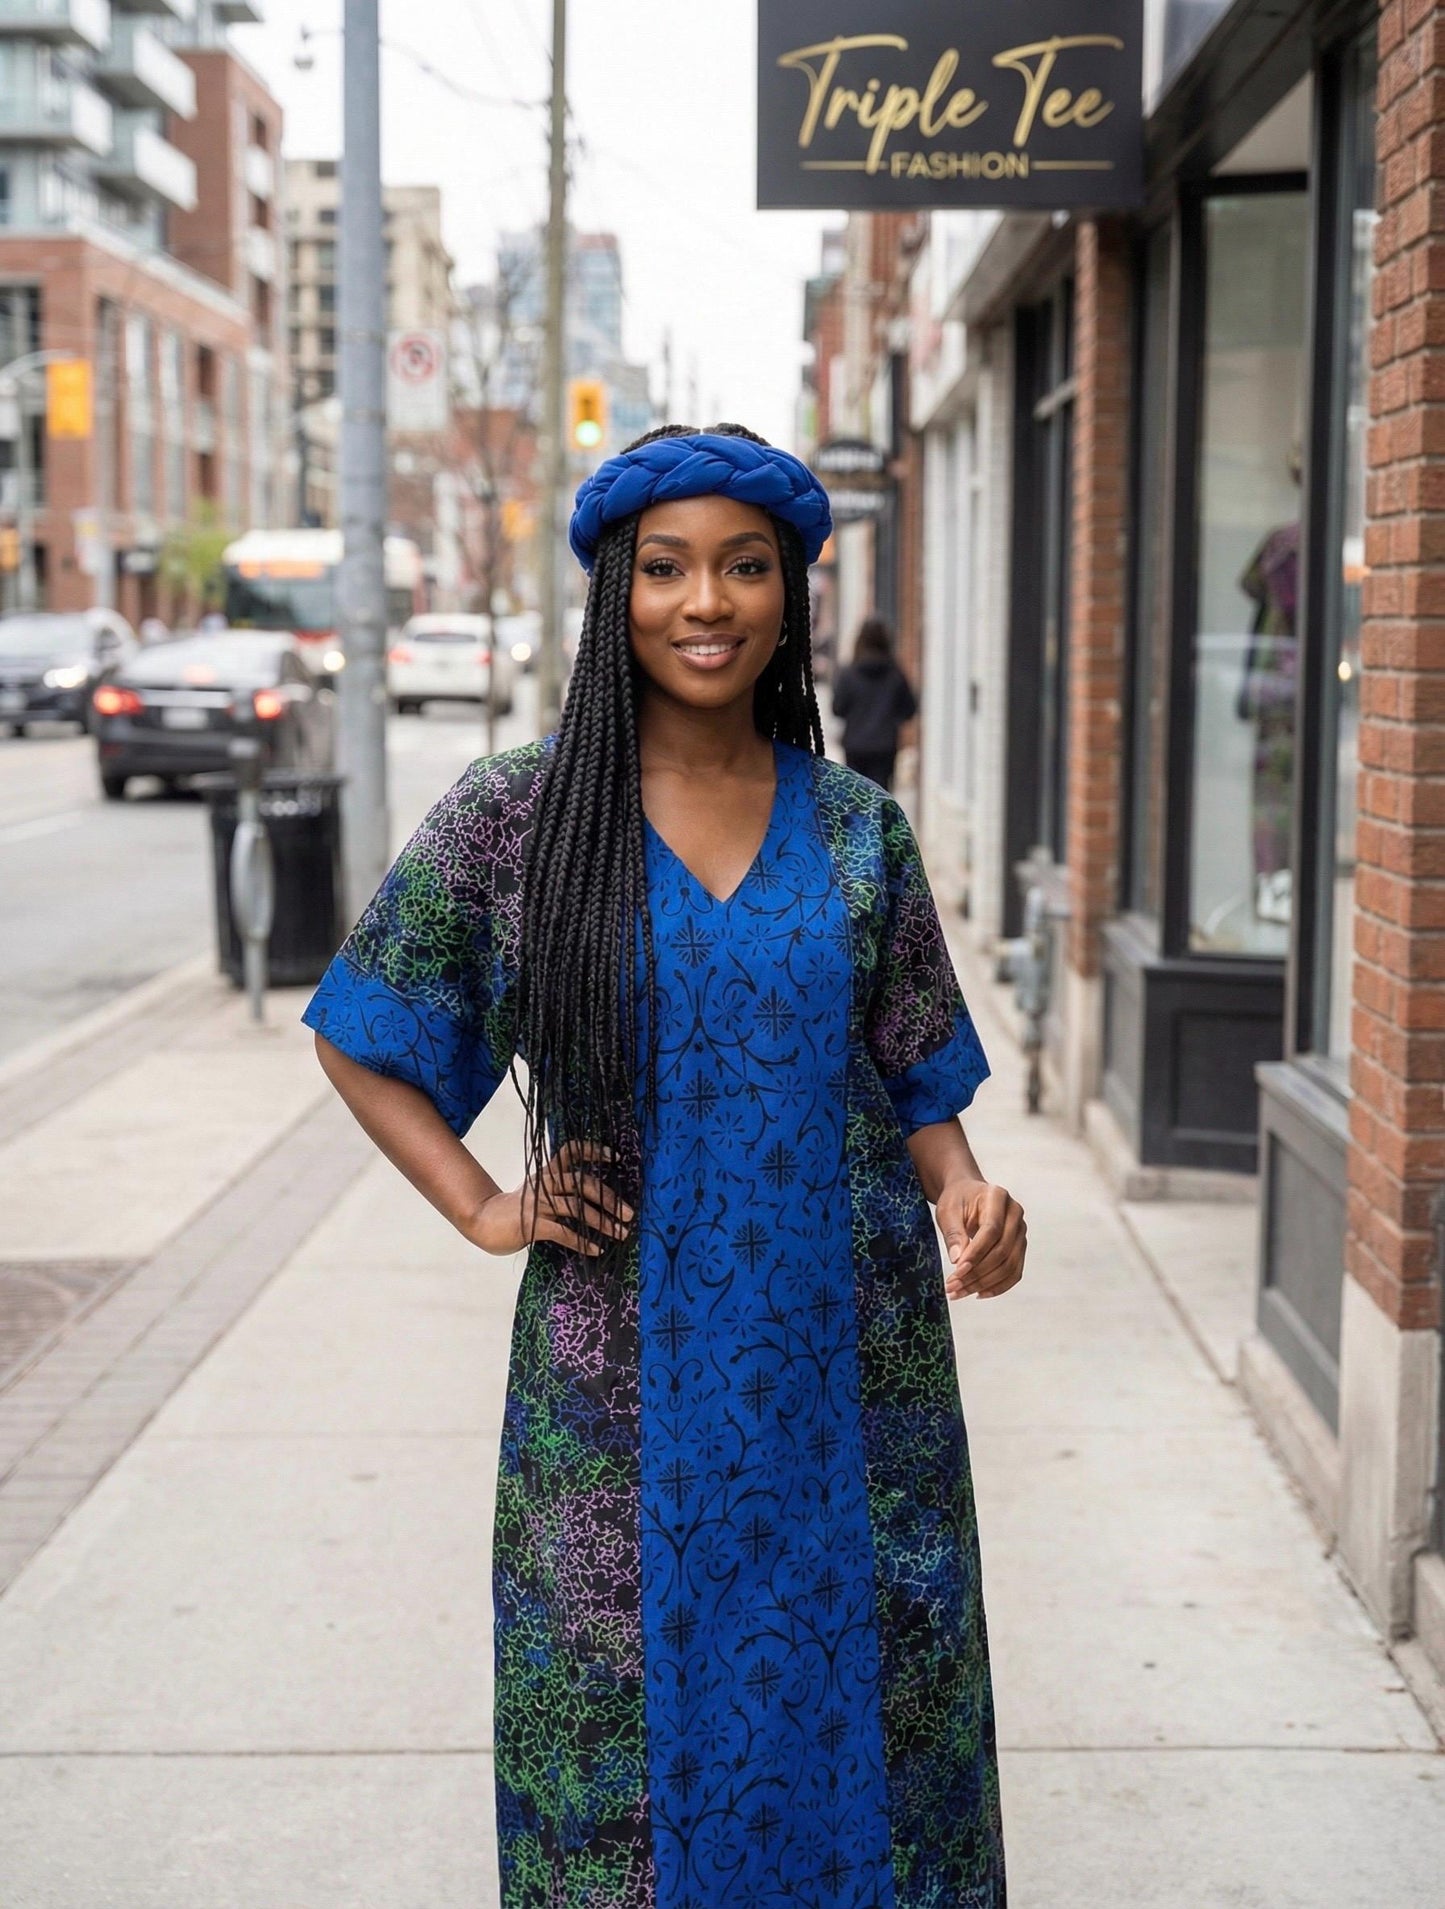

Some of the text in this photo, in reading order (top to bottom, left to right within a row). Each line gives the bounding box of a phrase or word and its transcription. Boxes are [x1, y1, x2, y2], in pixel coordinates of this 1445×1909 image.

[777, 33, 1124, 175] Triple Tee
[890, 151, 1030, 179] FASHION
